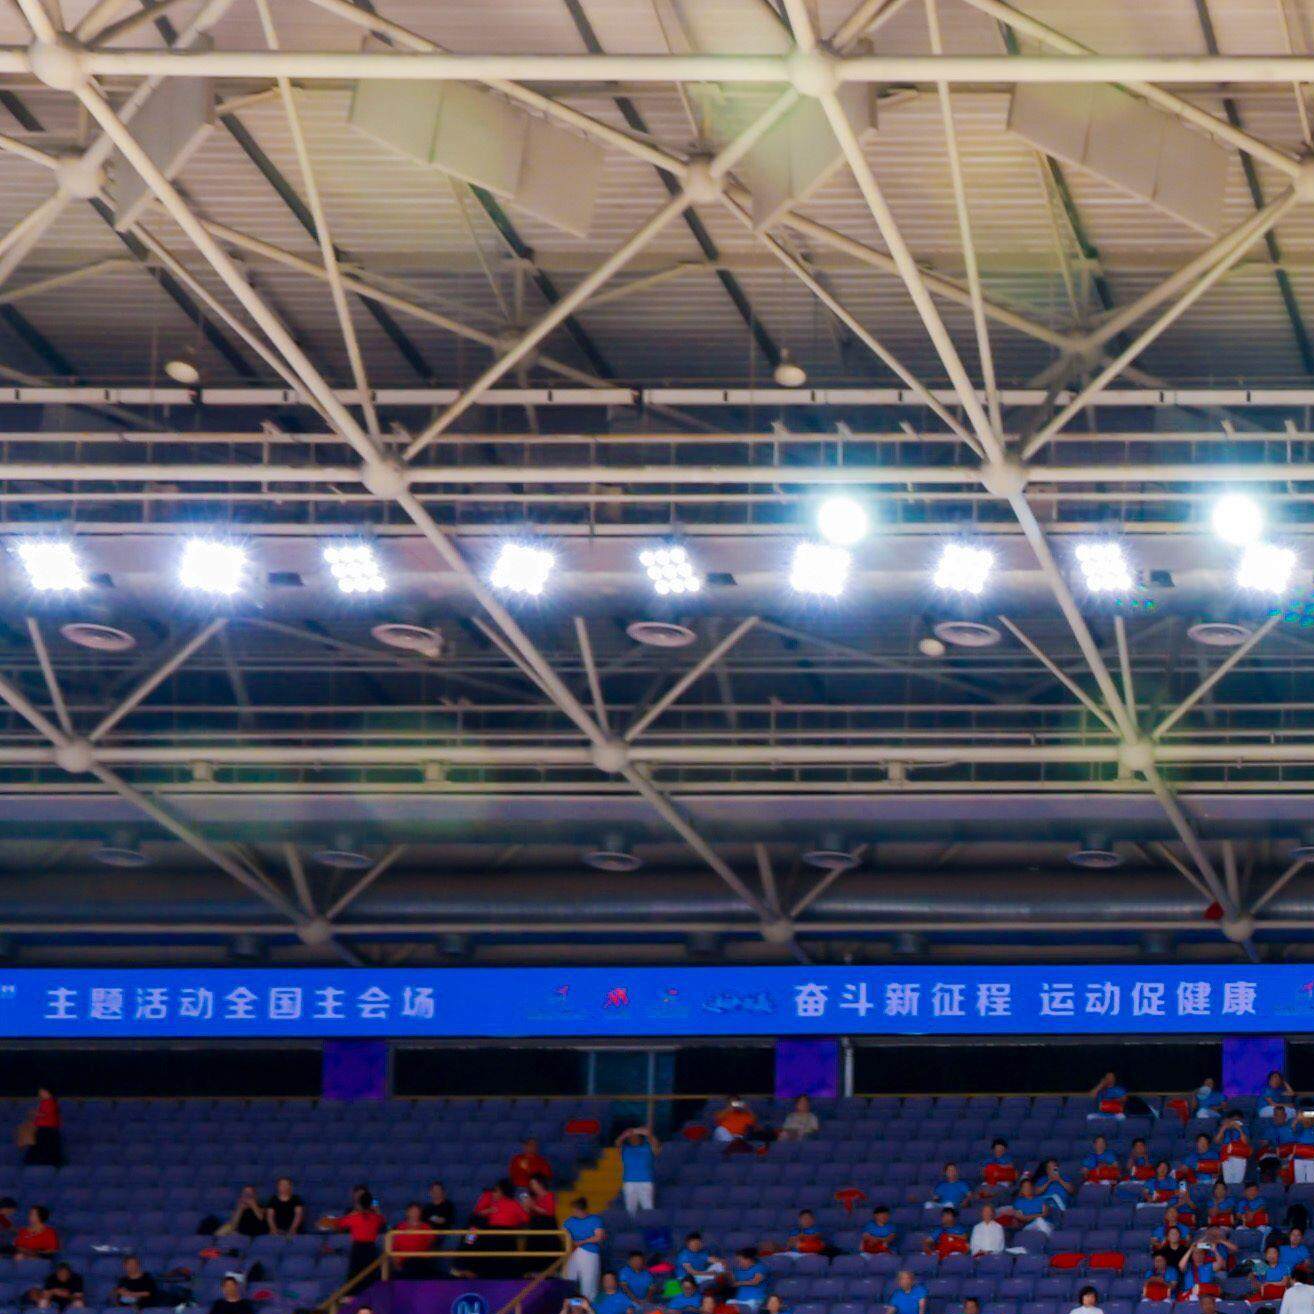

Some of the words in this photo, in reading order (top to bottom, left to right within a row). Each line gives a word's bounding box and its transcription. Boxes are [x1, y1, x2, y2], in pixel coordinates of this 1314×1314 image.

[794, 982, 1012, 1017] 奋斗新征程
[1040, 981, 1258, 1017] 运动促健康
